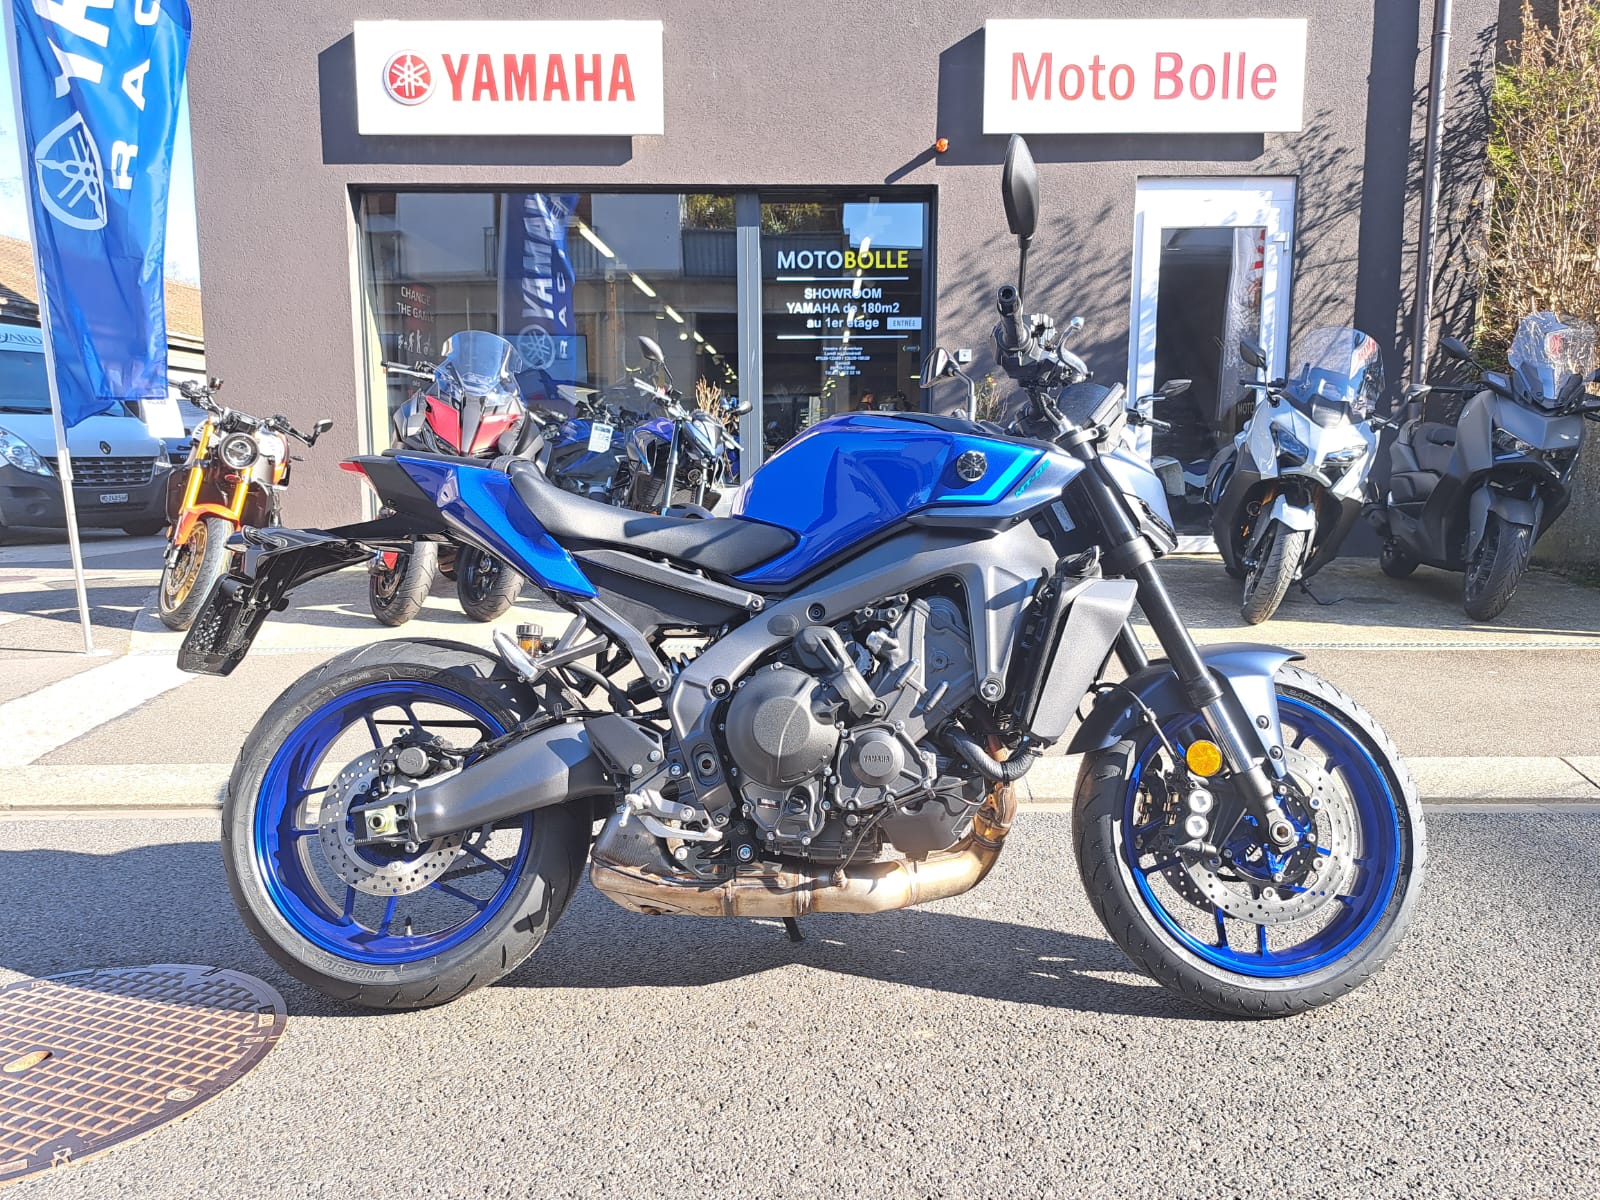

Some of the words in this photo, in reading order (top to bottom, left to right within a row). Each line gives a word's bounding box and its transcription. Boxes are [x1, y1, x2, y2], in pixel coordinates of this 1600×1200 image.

[441, 53, 636, 102] YAMAHA
[1011, 52, 1136, 101] Moto
[1153, 52, 1278, 101] Bolle
[777, 250, 909, 270] MOTOBOLLE
[401, 286, 431, 306] CHANGE
[804, 287, 882, 300] SHOWROOM
[396, 301, 412, 317] THE
[786, 302, 841, 314] YAMAHA
[843, 302, 858, 314] de
[861, 302, 900, 314] 180m2
[806, 319, 822, 329] au
[825, 318, 844, 329] 1er
[863, 754, 890, 764] YAMAHA
